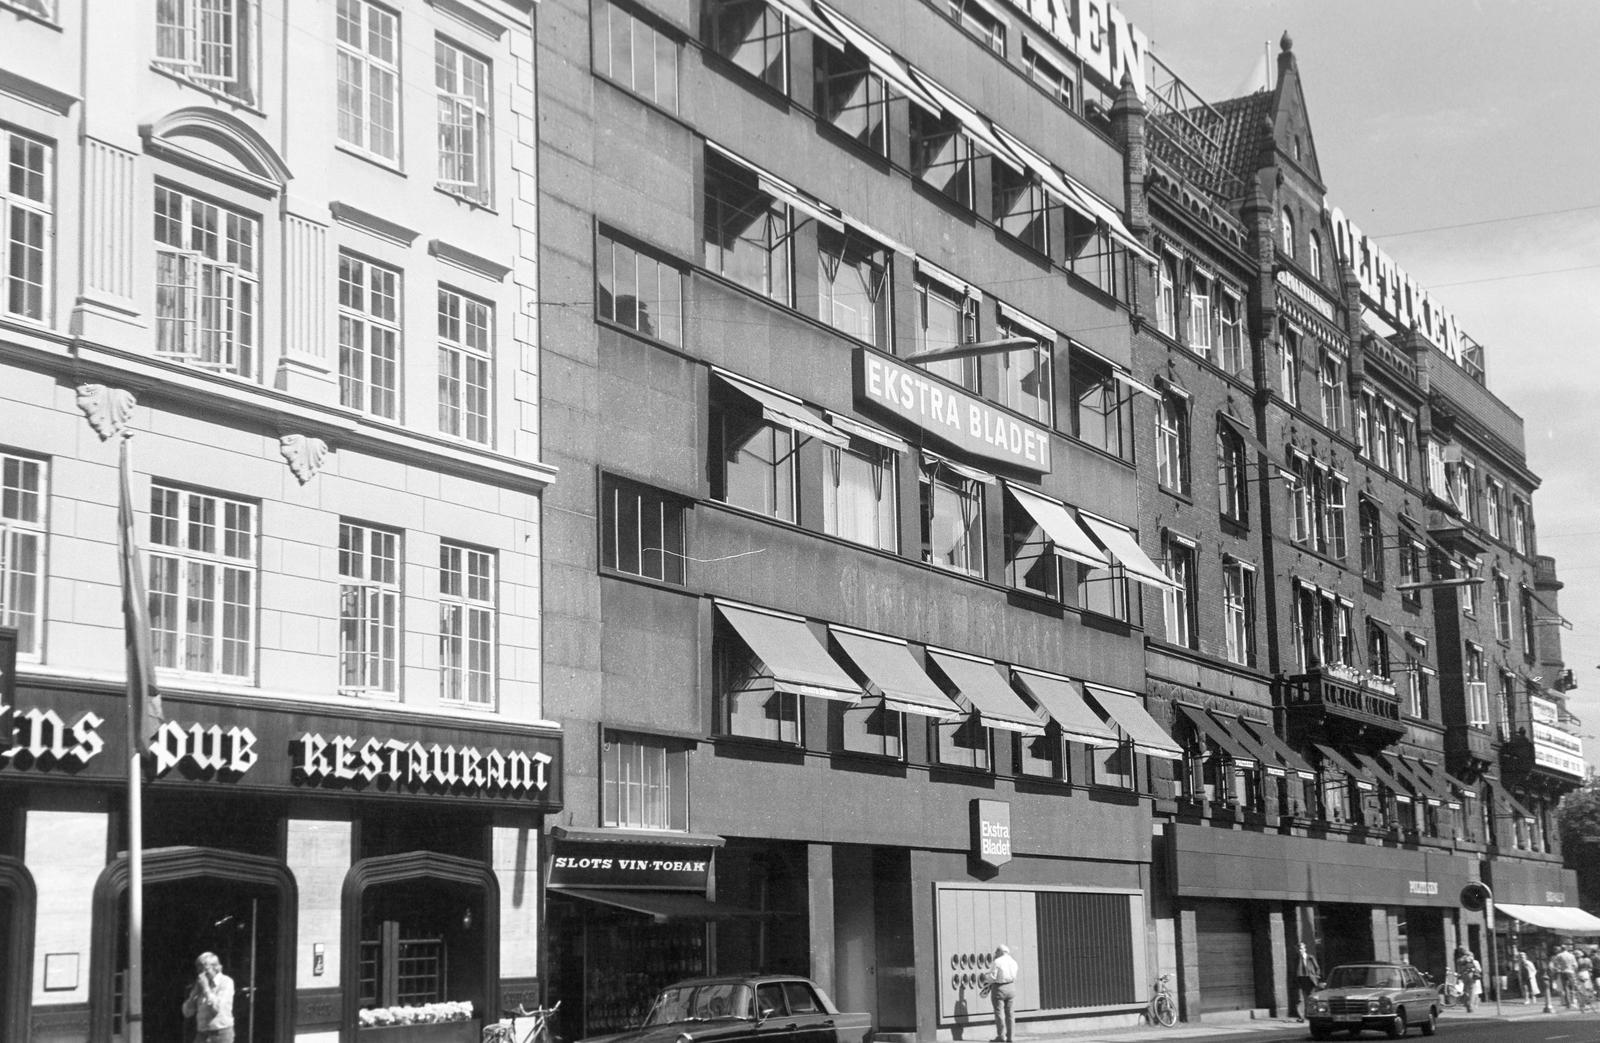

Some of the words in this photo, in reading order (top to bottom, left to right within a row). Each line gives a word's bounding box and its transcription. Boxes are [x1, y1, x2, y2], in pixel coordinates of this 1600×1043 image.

[1323, 195, 1463, 368] OLITIKEN
[868, 358, 961, 431] EKSTRA
[969, 403, 1047, 466] BLADET
[300, 732, 553, 792] RESTAURANT
[981, 820, 1010, 839] Ekstra
[982, 838, 1011, 856] Bladet
[554, 857, 613, 870] SLOTS
